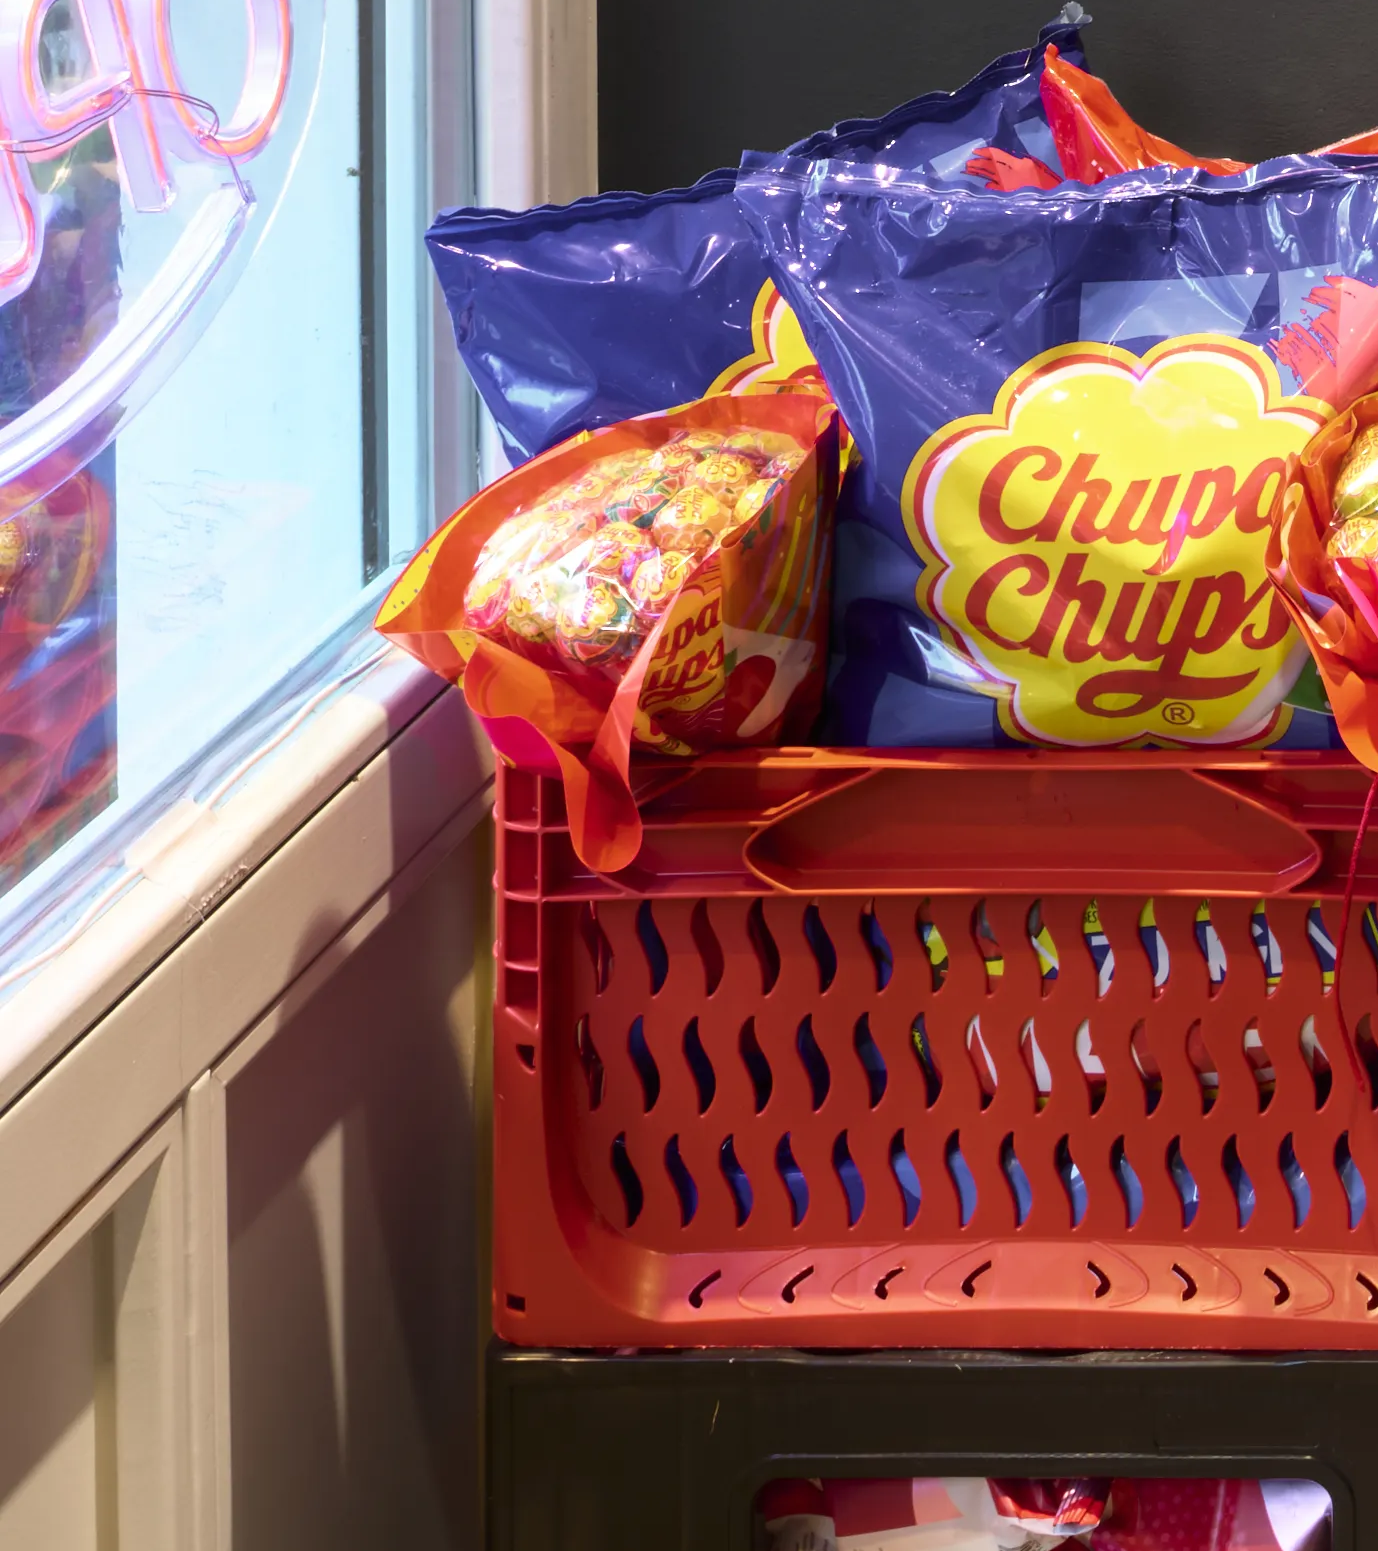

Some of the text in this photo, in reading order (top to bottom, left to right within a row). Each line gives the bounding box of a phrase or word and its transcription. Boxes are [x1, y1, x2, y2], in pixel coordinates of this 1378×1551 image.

[978, 445, 1287, 576] Chupa
[638, 637, 725, 712] ups
[650, 597, 721, 667] upa
[964, 552, 1292, 718] Chups
